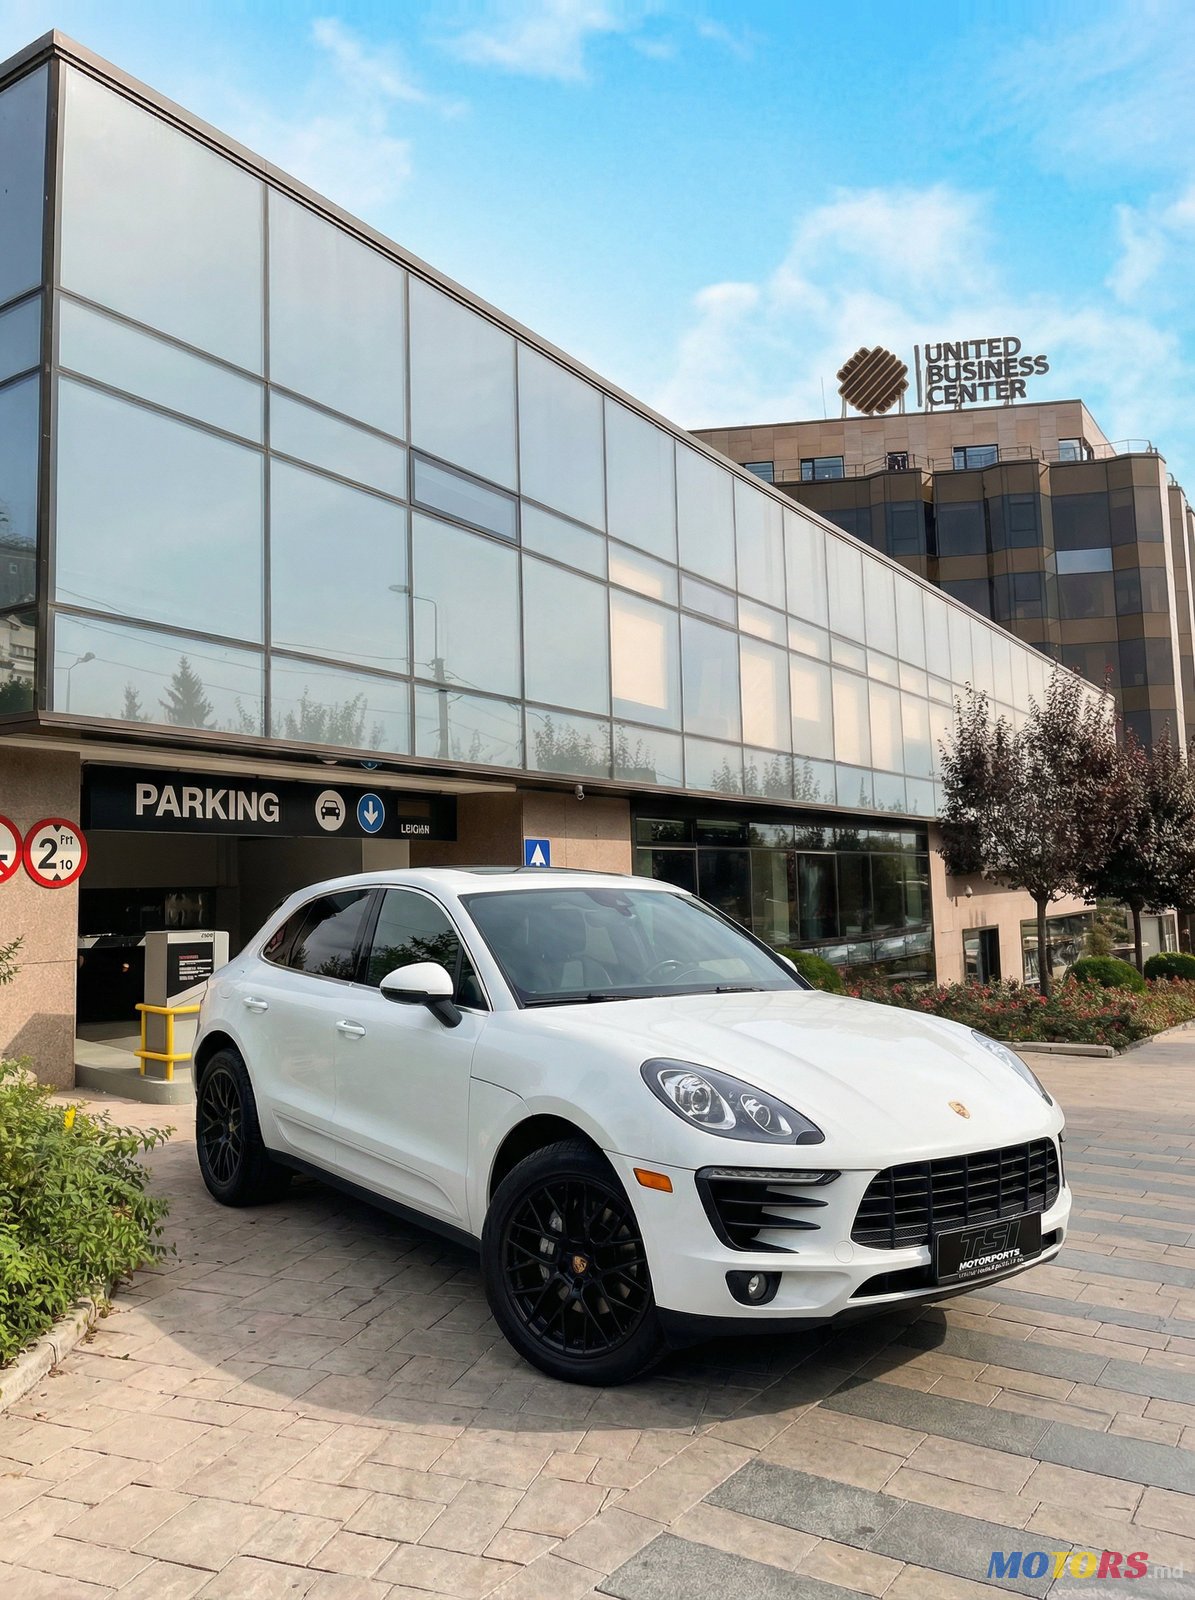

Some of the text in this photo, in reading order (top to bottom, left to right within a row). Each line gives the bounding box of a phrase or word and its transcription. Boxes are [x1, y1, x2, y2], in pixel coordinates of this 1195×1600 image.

[924, 336, 1022, 363] UNITED
[926, 354, 1050, 385] BUSINESS
[927, 378, 1027, 406] CENTER
[135, 783, 280, 823] PARKING
[38, 837, 58, 869] 2
[60, 859, 73, 870] 10
[960, 1220, 1021, 1260] TSI
